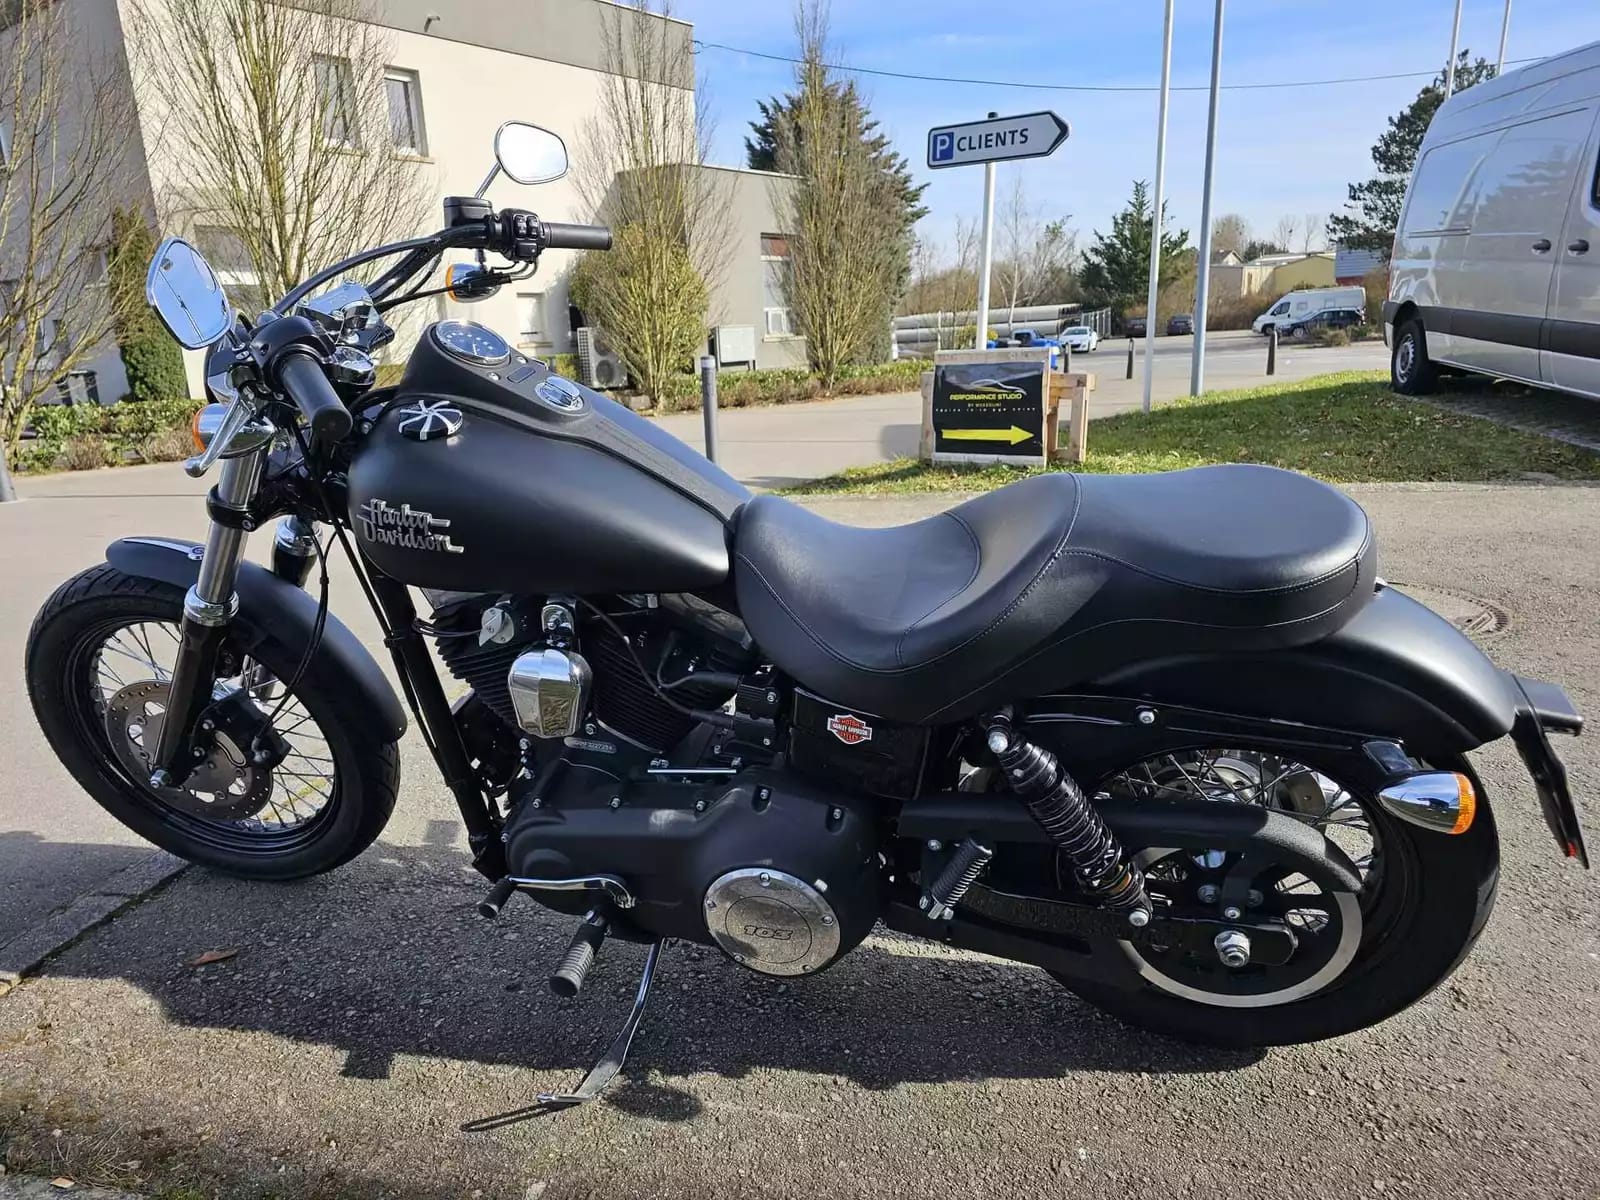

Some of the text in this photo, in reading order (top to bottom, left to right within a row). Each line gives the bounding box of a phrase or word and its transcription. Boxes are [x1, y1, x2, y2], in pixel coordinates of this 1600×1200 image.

[936, 128, 1029, 159] P CLIENTS
[997, 392, 1022, 400] STUDIO
[360, 497, 451, 536] Harley
[356, 513, 464, 553] Davidson
[743, 924, 793, 940] 103
